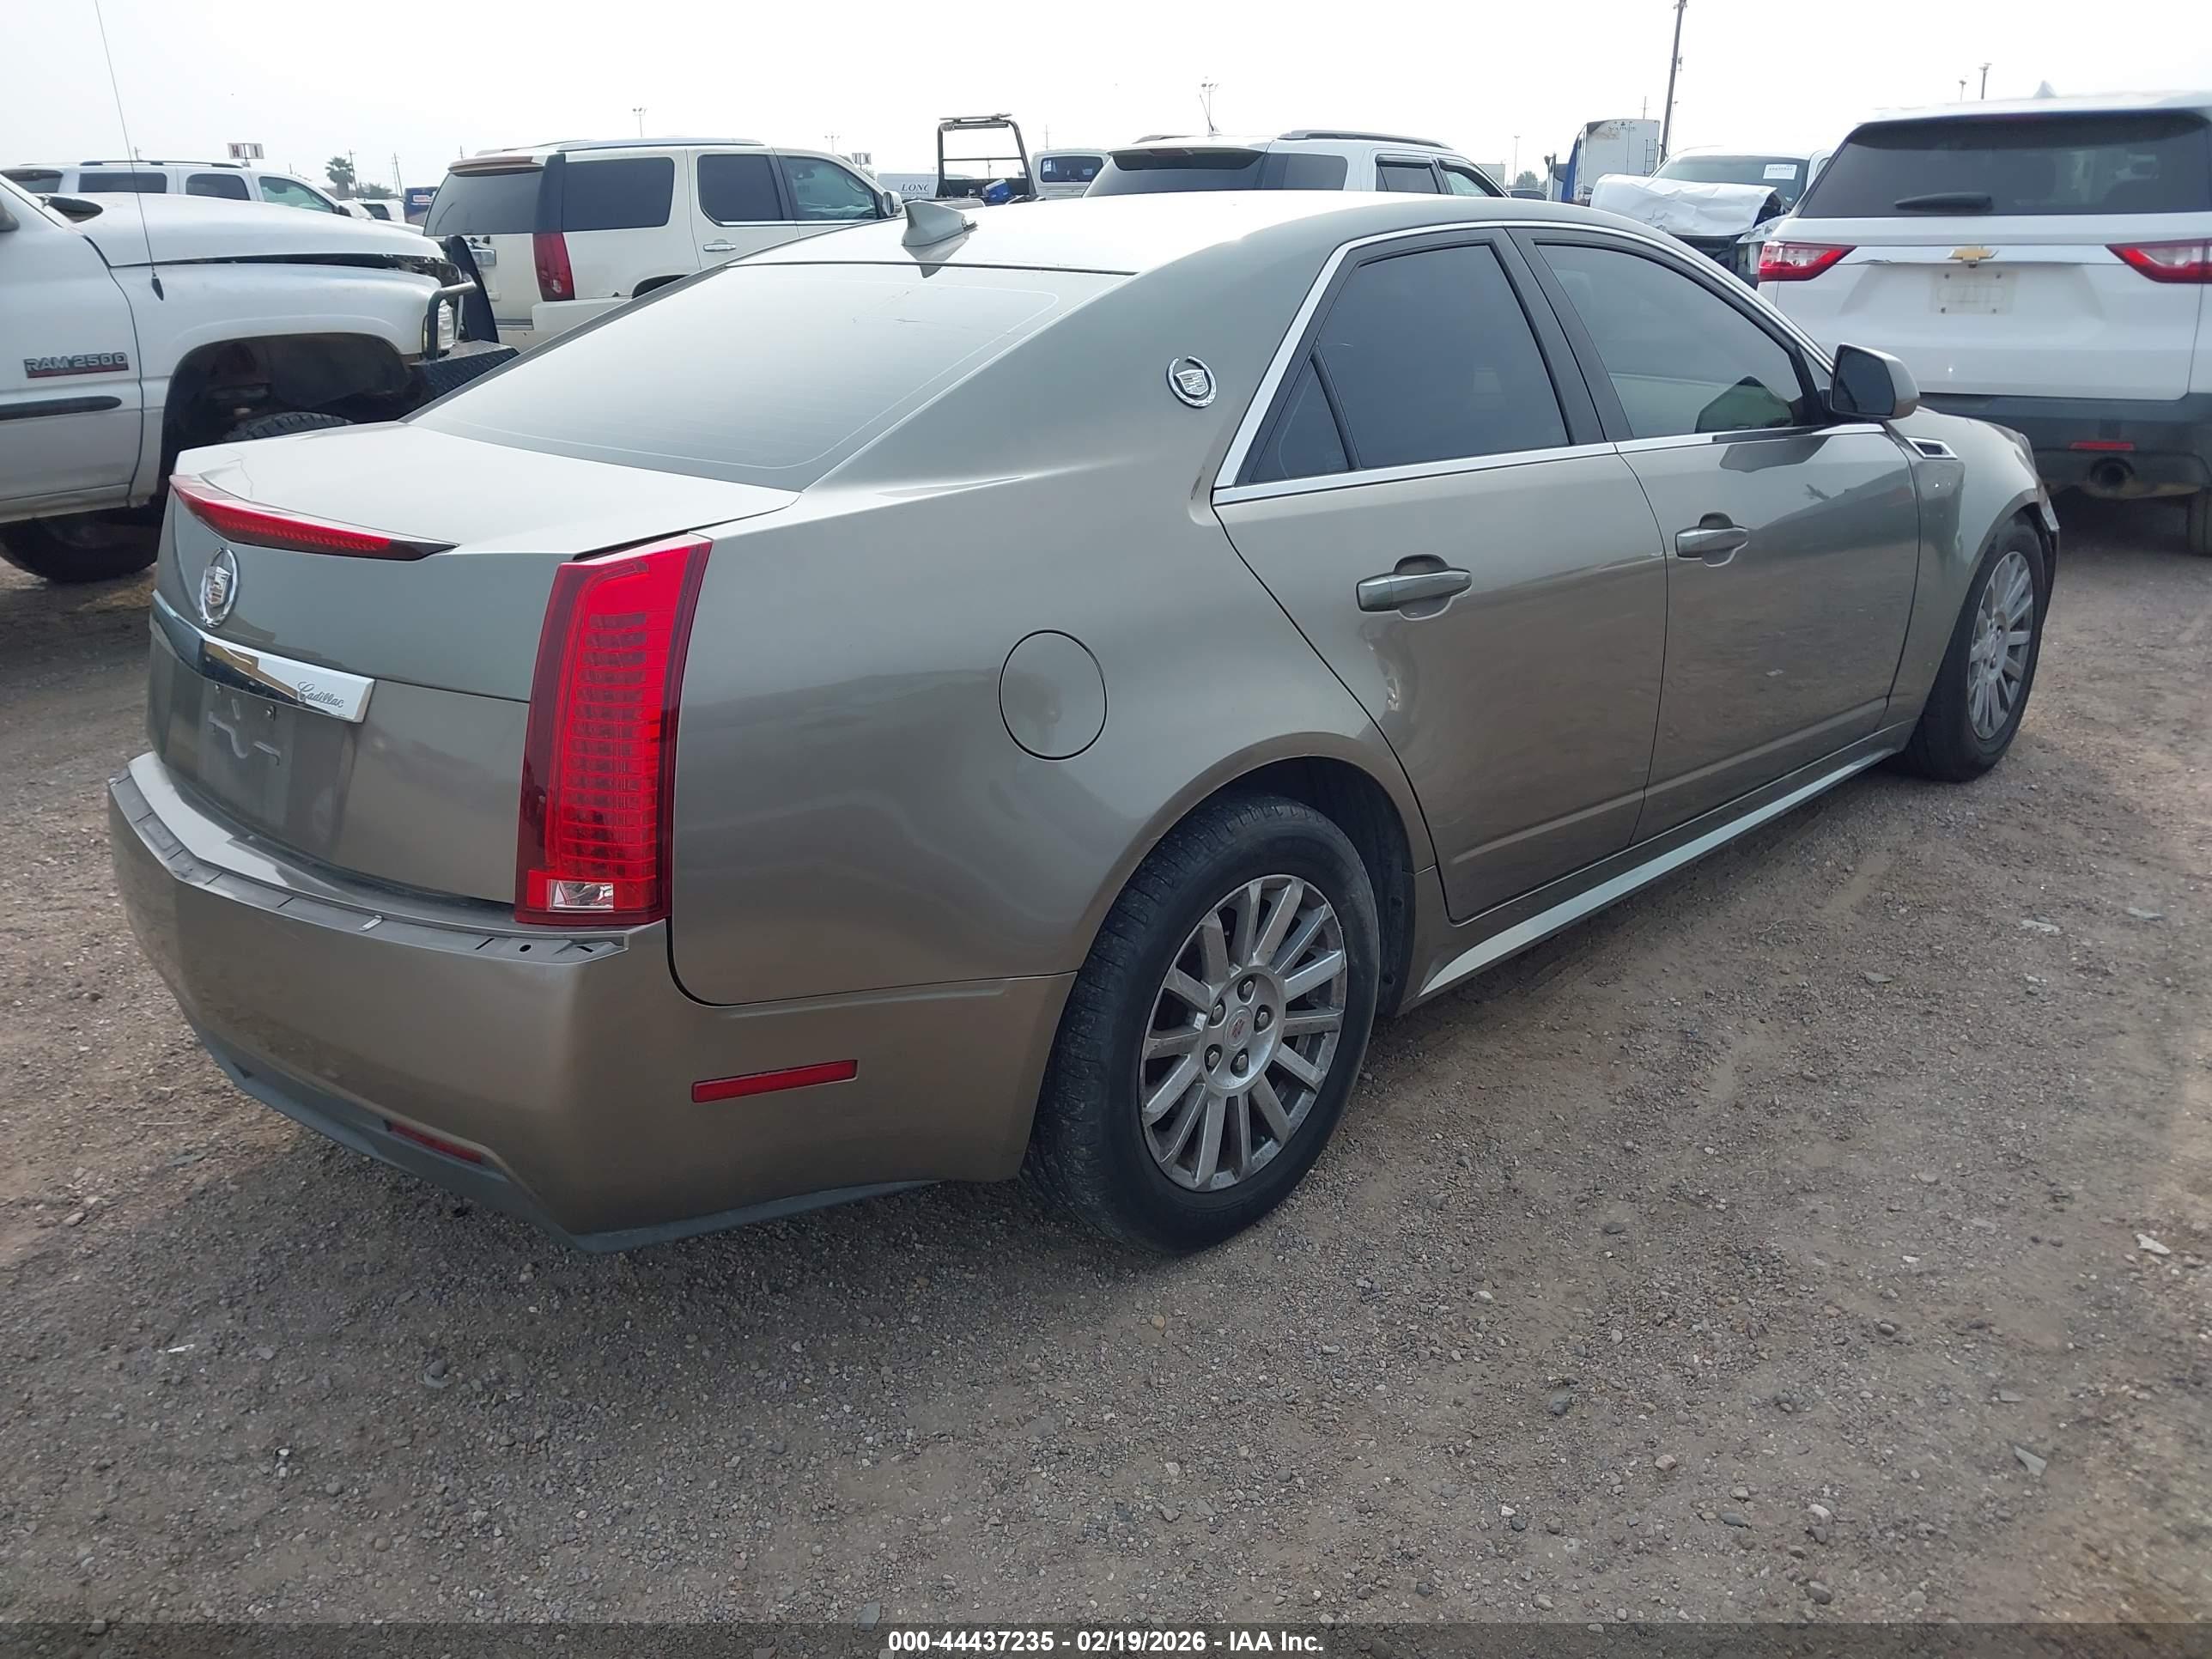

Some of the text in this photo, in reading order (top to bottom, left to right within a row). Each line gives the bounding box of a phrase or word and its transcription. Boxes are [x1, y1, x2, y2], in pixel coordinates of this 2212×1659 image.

[24, 352, 126, 371] RAM 2500
[297, 681, 344, 708] Cadillac
